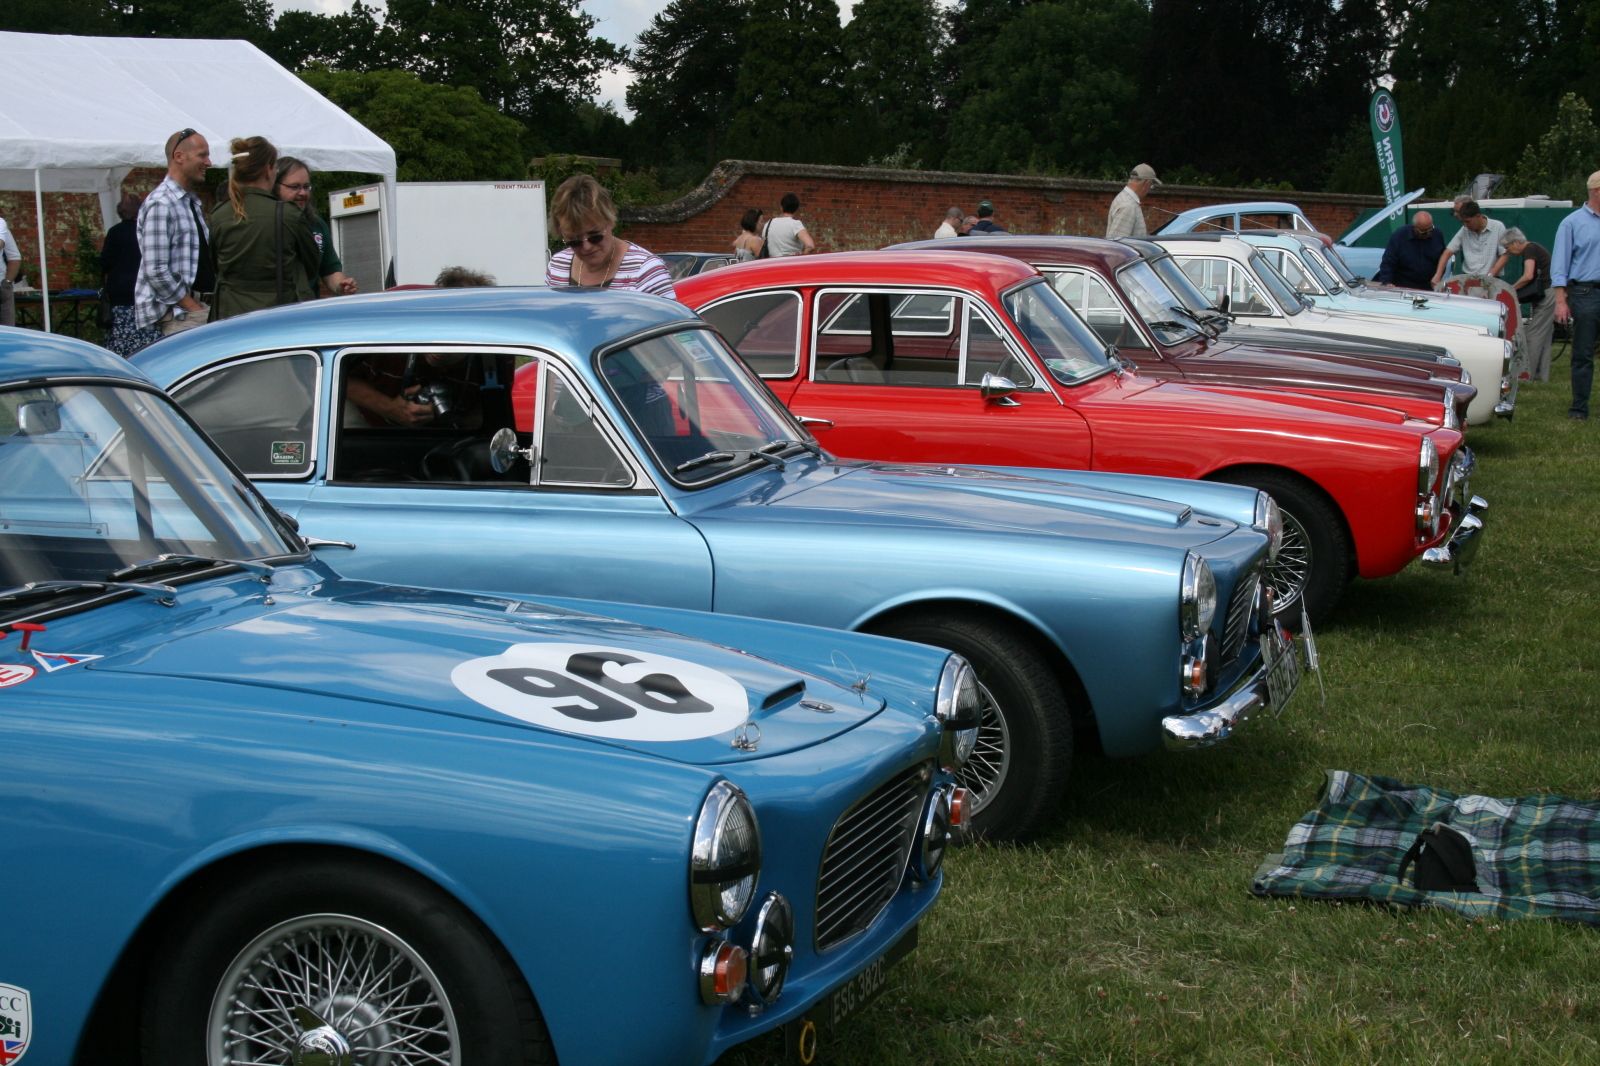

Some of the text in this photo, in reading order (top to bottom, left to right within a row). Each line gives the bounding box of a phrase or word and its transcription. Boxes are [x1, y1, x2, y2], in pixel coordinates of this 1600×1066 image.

[486, 652, 714, 722] 96
[834, 956, 886, 1024] ESG 382C
